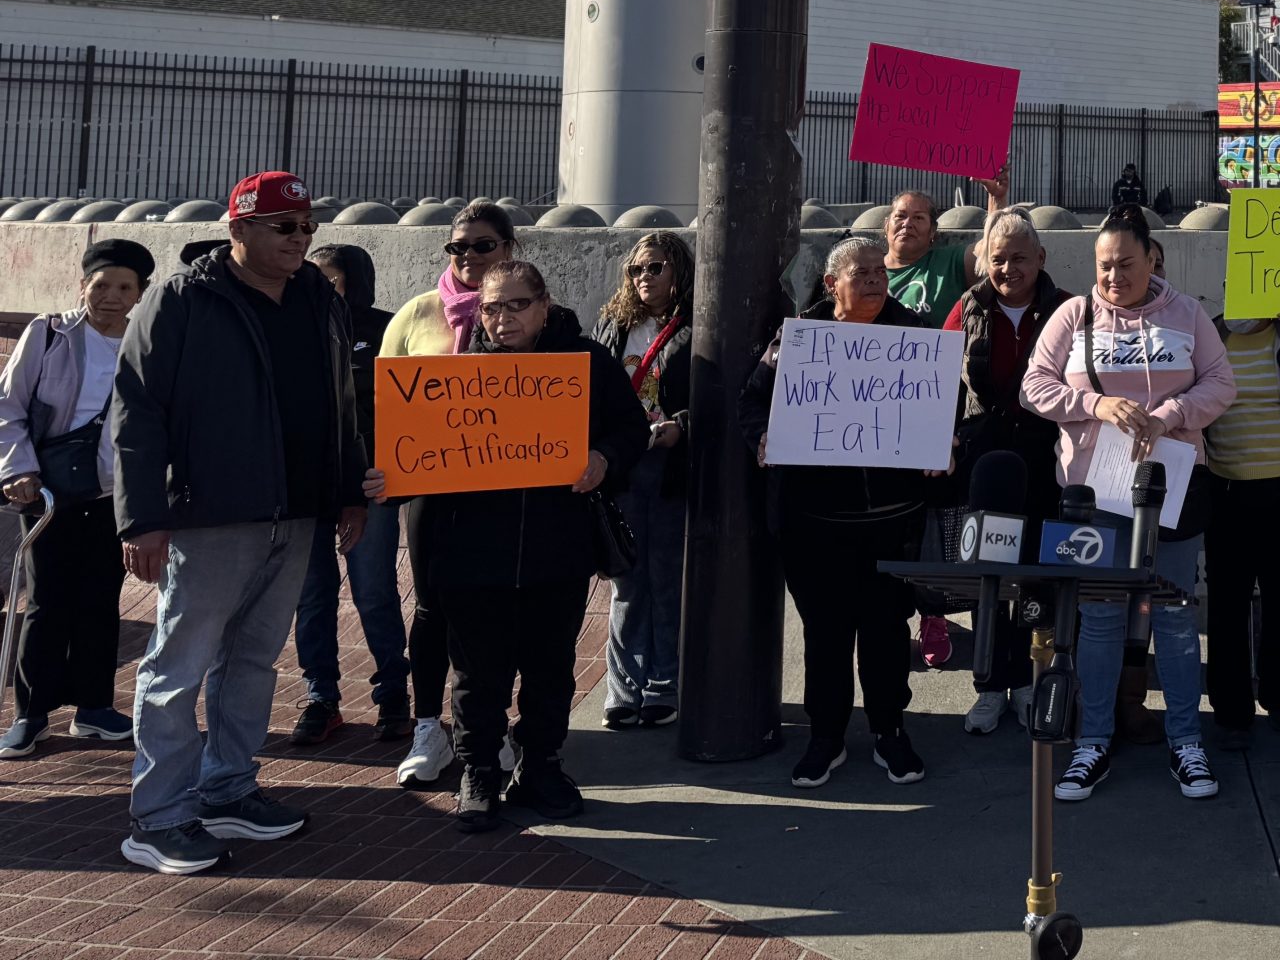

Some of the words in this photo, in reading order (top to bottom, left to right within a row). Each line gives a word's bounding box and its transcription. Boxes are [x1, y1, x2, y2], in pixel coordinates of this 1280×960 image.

[873, 48, 910, 90] We
[882, 128, 998, 180] Economy
[798, 325, 836, 366] If
[843, 336, 882, 362] we
[387, 363, 583, 404] Vendedores
[446, 407, 497, 429] con
[812, 402, 902, 456] Eat!
[394, 432, 570, 474] Certificados
[984, 531, 1018, 548] KPIX
[1055, 545, 1077, 556] abc
[1069, 526, 1104, 565] 7
